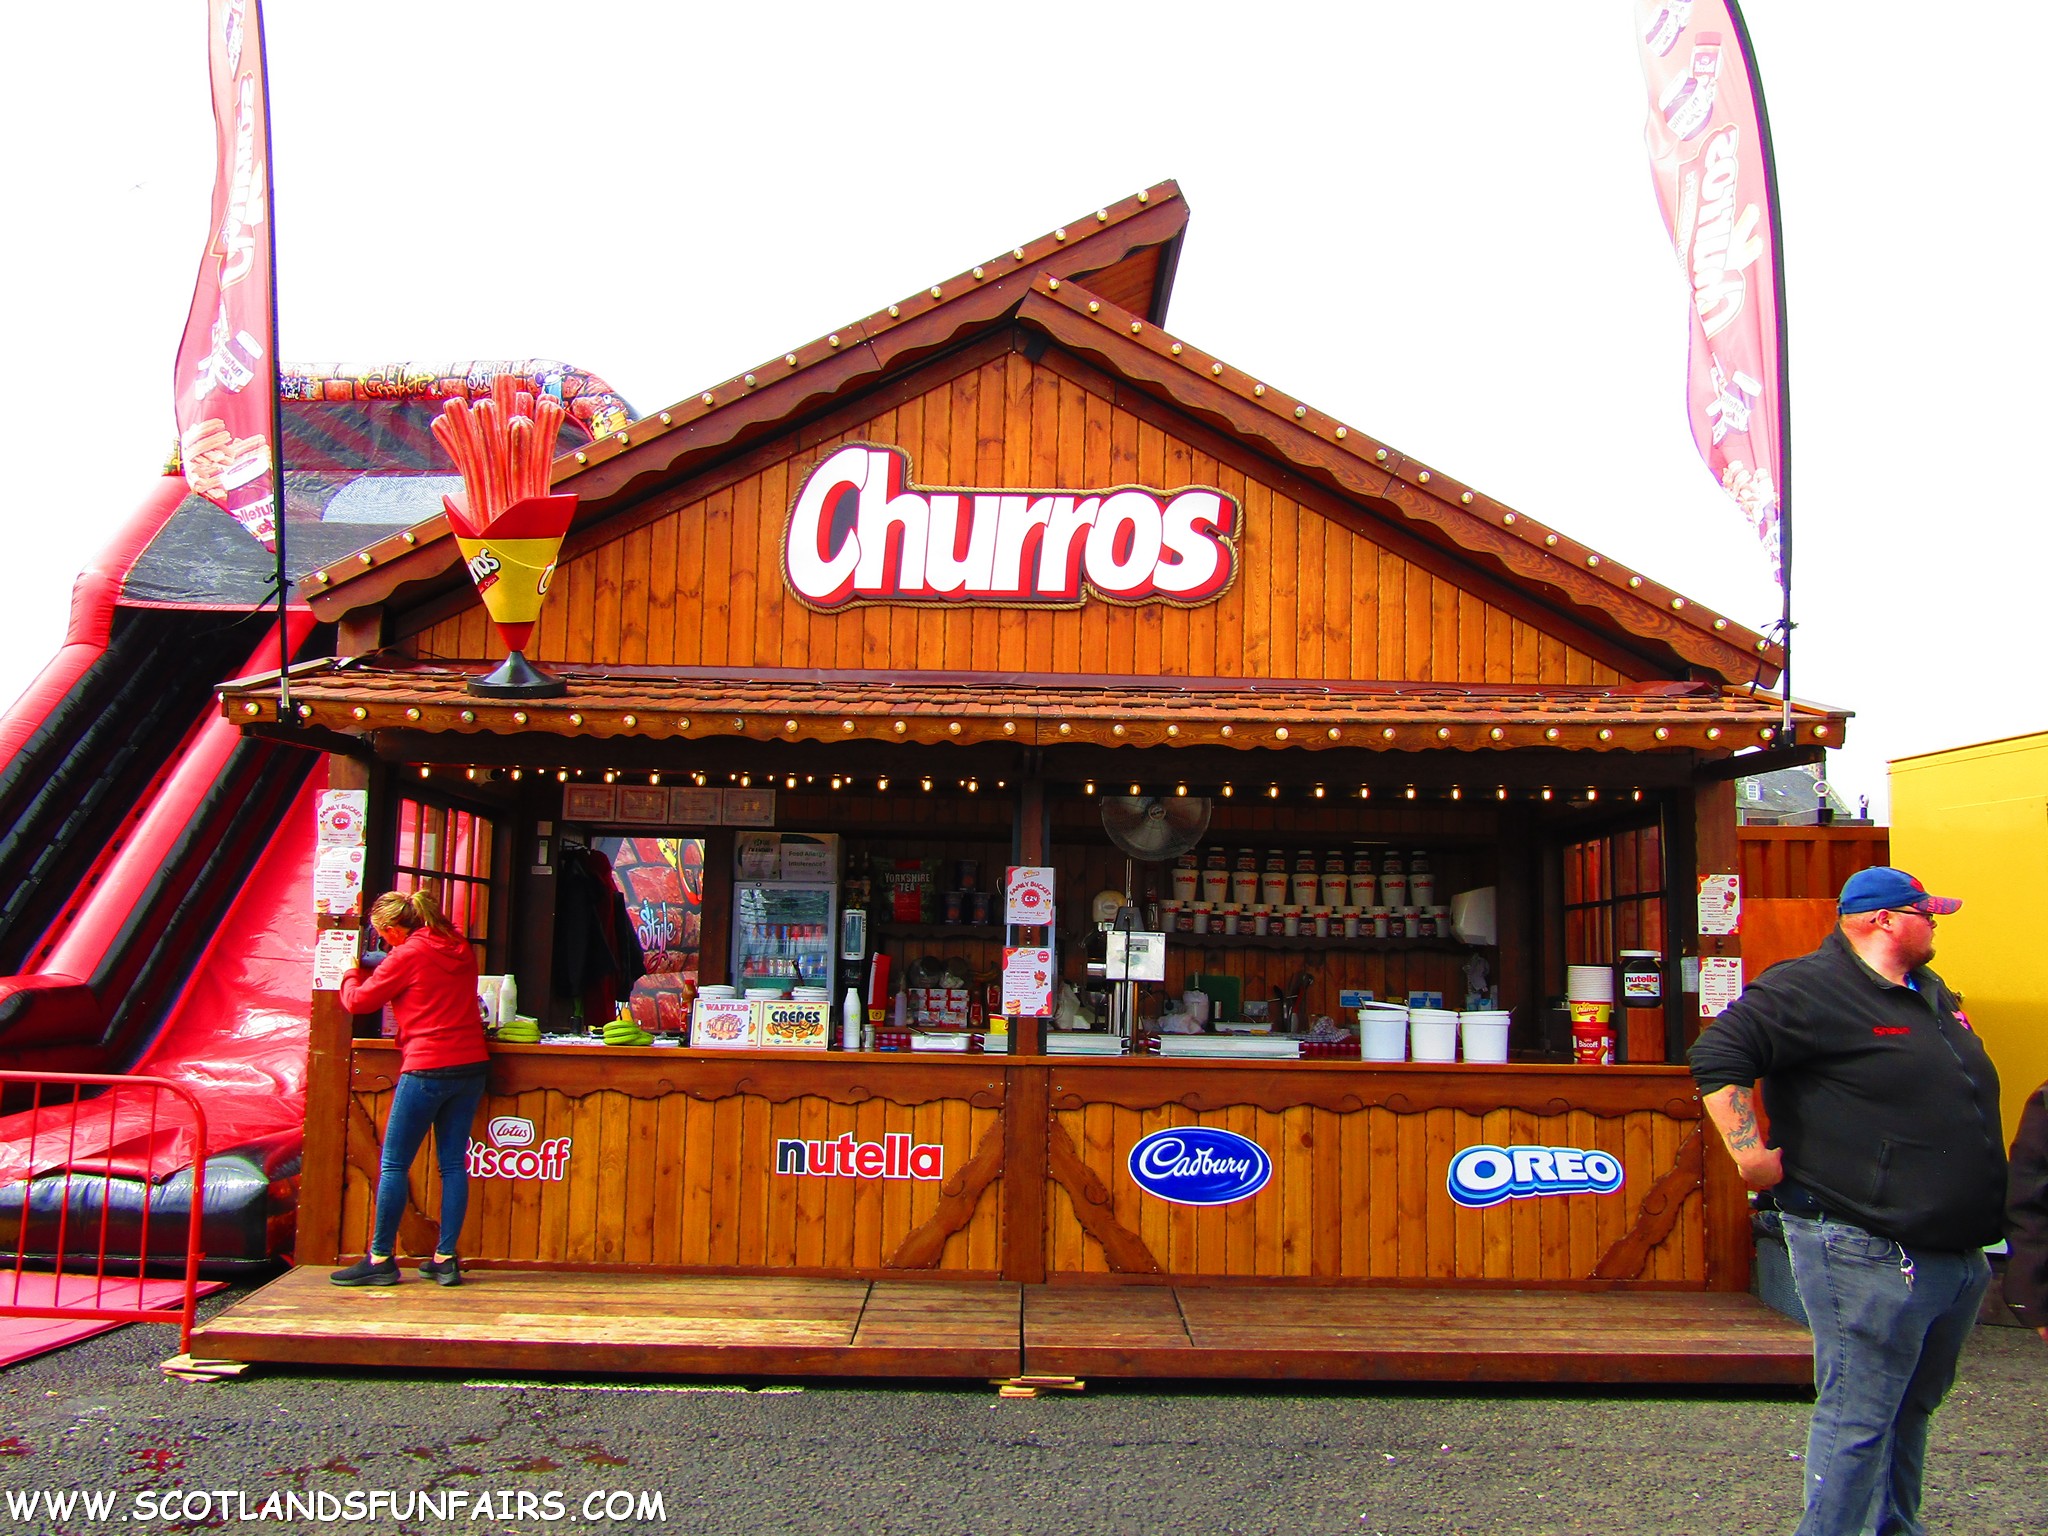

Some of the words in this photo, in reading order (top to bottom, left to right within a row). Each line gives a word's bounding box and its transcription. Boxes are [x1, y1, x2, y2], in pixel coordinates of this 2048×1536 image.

[786, 446, 1226, 600] Churros
[319, 804, 340, 819] FAMILY
[341, 803, 363, 818] BUCKET
[788, 850, 804, 858] Food
[804, 850, 827, 859] Allergy
[884, 872, 931, 883] YORKSHIRE
[900, 882, 916, 892] TEA
[1009, 881, 1030, 896] FAMILY
[1030, 881, 1052, 897] BUCKET
[637, 898, 677, 975] Style
[1625, 975, 1658, 983] nutella
[705, 1003, 749, 1012] WAFFLES
[771, 1010, 821, 1024] CREPES
[1872, 1026, 1911, 1037] Shaun
[1578, 1040, 1599, 1048] Biscoff
[496, 1122, 528, 1138] Lotus
[777, 1134, 942, 1178] nutella
[1138, 1137, 1251, 1181] Cadbury
[1455, 1149, 1618, 1192] OREO
